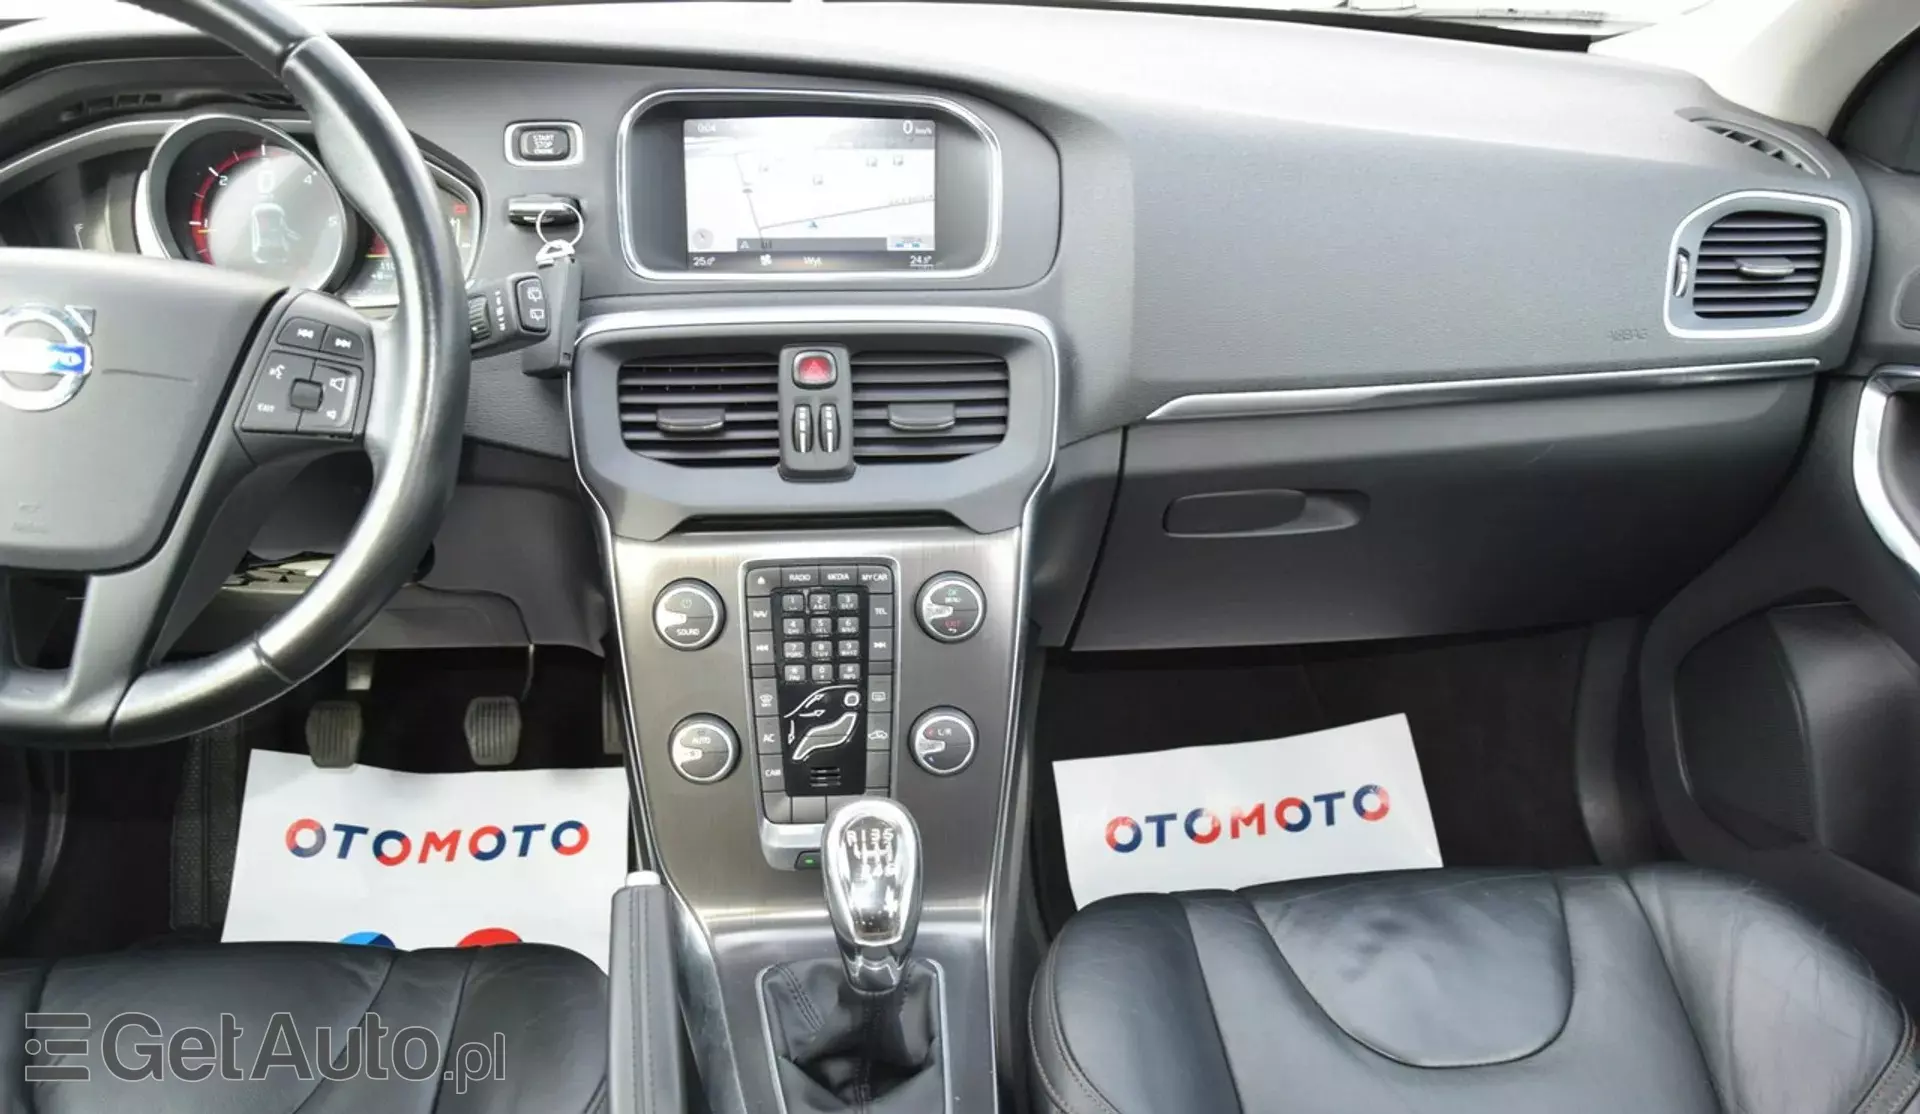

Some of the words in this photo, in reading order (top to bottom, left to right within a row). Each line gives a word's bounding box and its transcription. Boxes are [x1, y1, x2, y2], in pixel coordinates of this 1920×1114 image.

[902, 120, 914, 134] 0
[218, 175, 229, 186] 2
[303, 174, 313, 184] 4
[788, 573, 811, 581] RADIO
[827, 573, 850, 581] MEDIA
[873, 573, 888, 581] CAR
[753, 610, 768, 618] NAV
[874, 607, 888, 615] TEL
[676, 628, 700, 636] SOUND
[763, 733, 775, 742] AC
[1105, 784, 1390, 853] OTOMOTO
[285, 818, 590, 867] OTOMOTO
